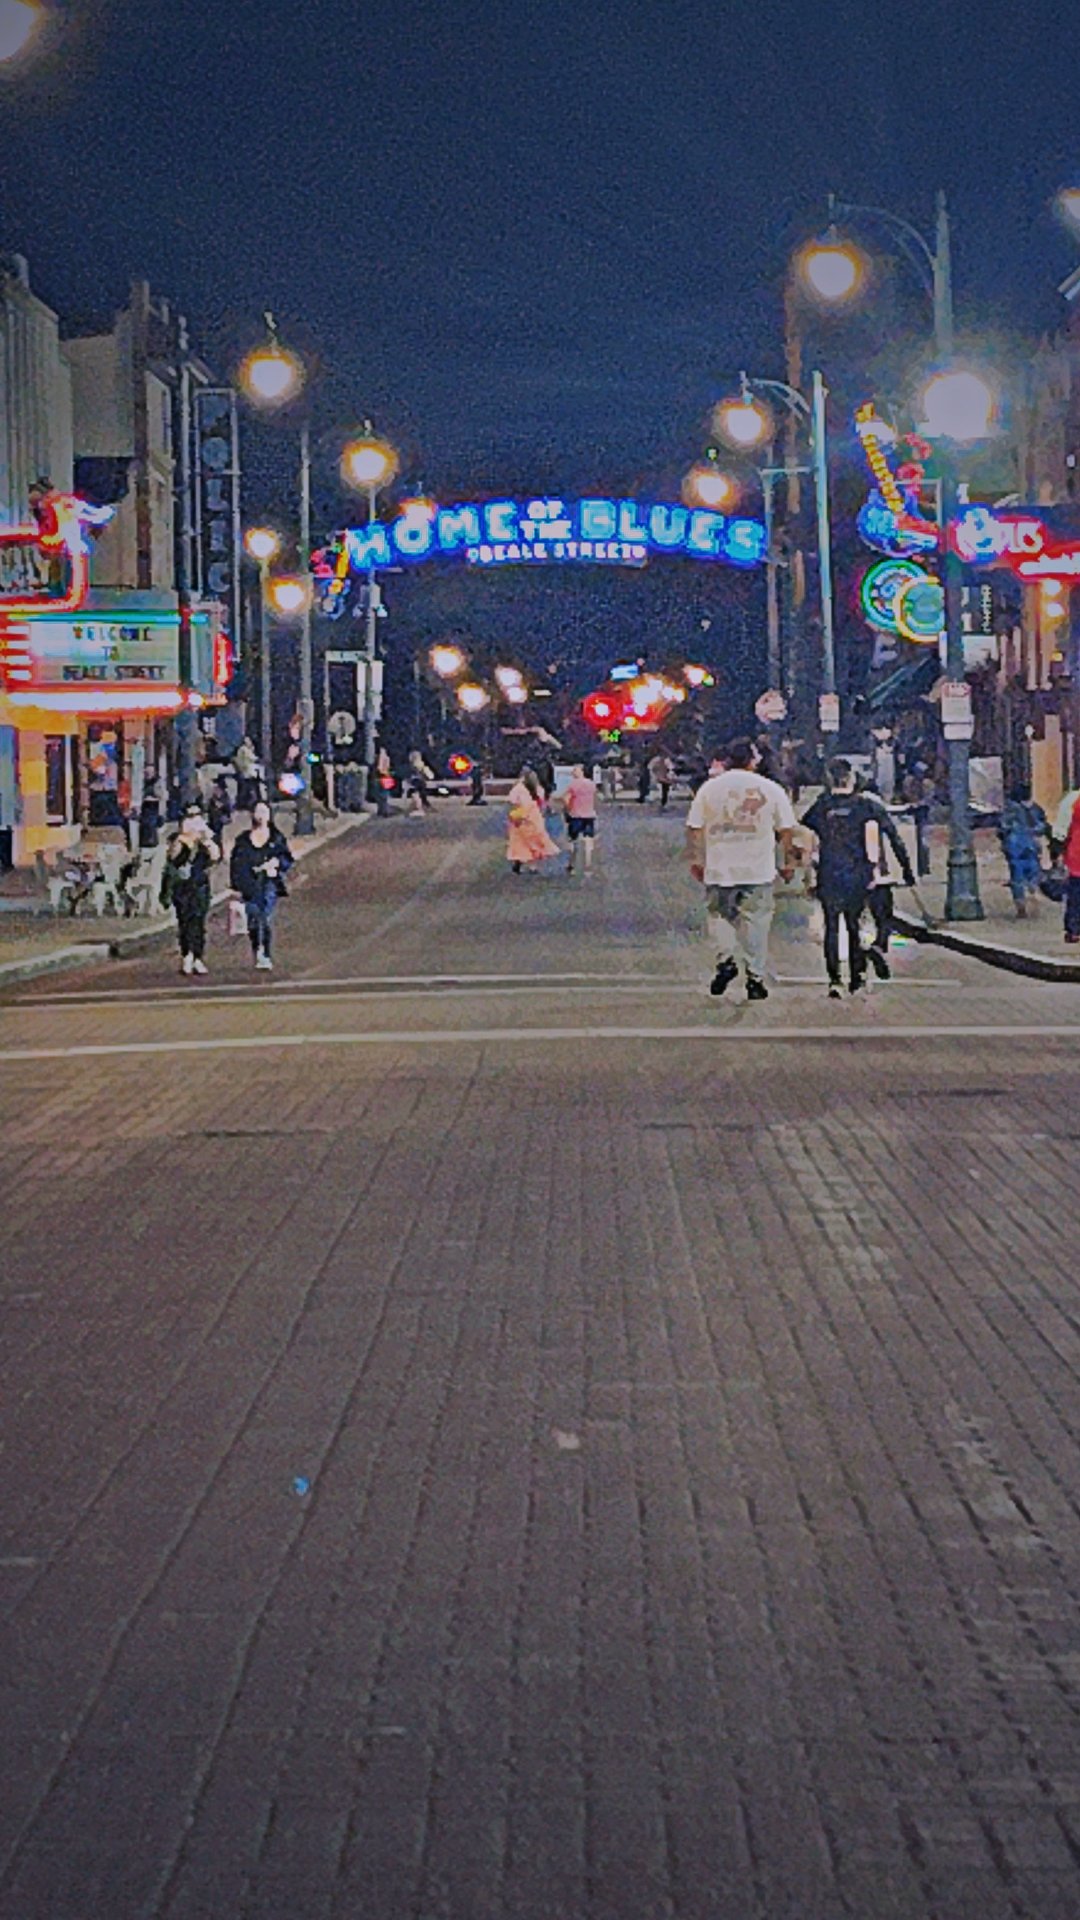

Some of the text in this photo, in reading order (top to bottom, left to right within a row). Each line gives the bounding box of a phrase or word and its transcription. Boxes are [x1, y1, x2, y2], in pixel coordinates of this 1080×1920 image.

[347, 498, 765, 569] HOME OF THE BLUES
[479, 541, 631, 562] BEALE STREET
[72, 625, 153, 642] WELCOME
[101, 645, 121, 662] TO
